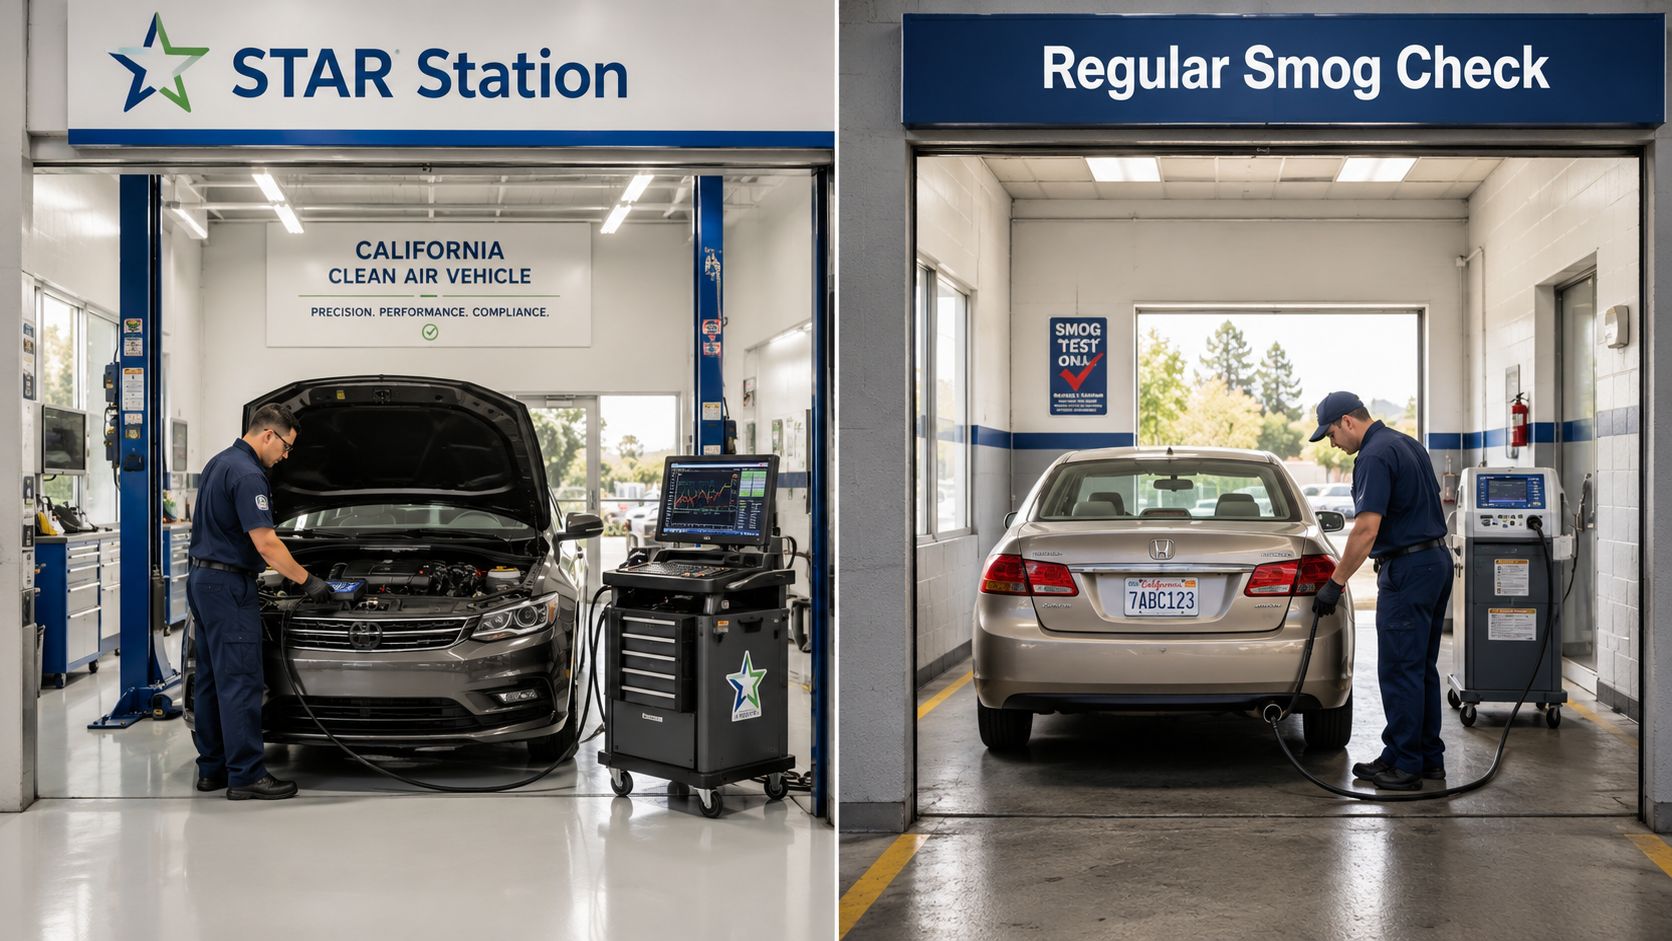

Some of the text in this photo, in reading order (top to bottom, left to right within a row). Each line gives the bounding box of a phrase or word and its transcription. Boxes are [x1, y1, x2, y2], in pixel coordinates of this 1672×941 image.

[232, 47, 628, 99] STAR Station
[1043, 44, 1551, 101] Regular Smog Check
[355, 240, 505, 261] CALIFORNIA
[328, 267, 532, 284] CLEAN AIR VEHICLE
[311, 306, 550, 318] PRECISION. PERFORMANCE. COMPLIANCE.
[1055, 322, 1101, 337] SMOG
[1057, 338, 1101, 353] TEST
[1129, 591, 1195, 610] 7ABC123
